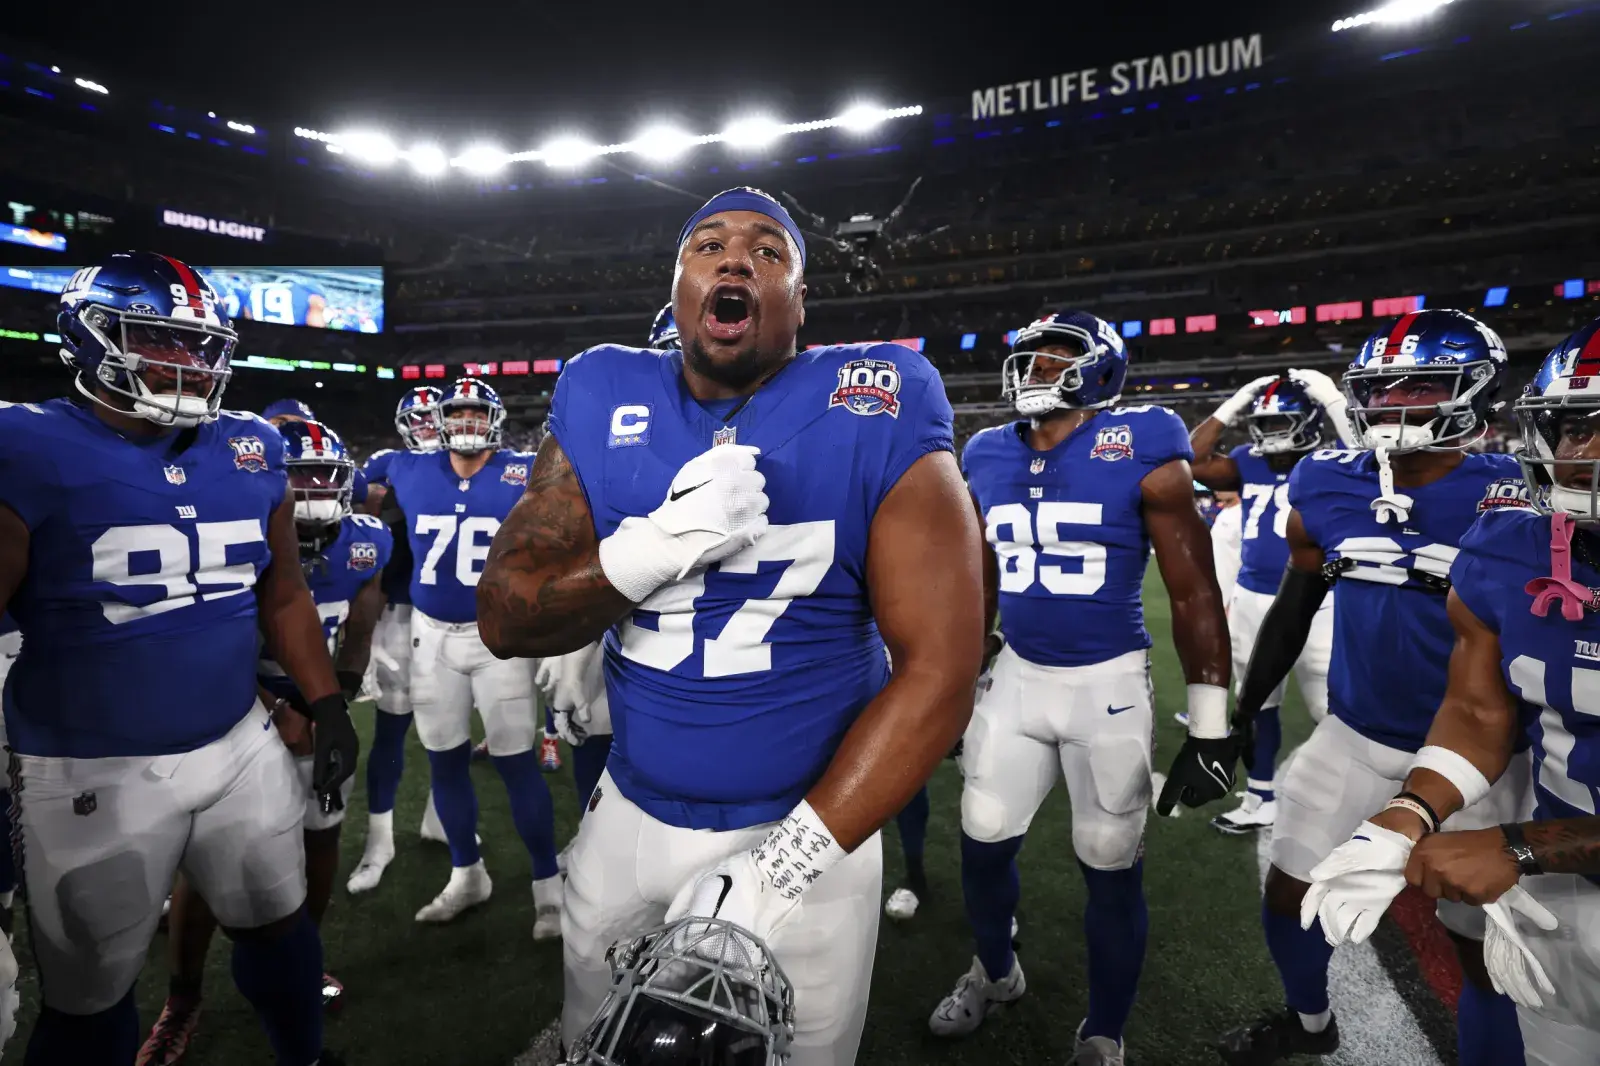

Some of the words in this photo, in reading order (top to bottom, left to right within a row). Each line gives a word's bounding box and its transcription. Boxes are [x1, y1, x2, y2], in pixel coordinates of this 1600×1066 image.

[971, 68, 1099, 121] METLIFE
[1110, 33, 1262, 95] STADIUM
[163, 209, 208, 231] BUD
[208, 218, 266, 242] LIGHT
[840, 367, 899, 394] 100
[842, 388, 890, 401] SEASONS
[611, 404, 650, 437] C
[232, 442, 265, 456] 100
[1096, 431, 1130, 446] 100
[413, 513, 503, 587] 76
[985, 501, 1107, 595] 85
[91, 518, 265, 625] 95
